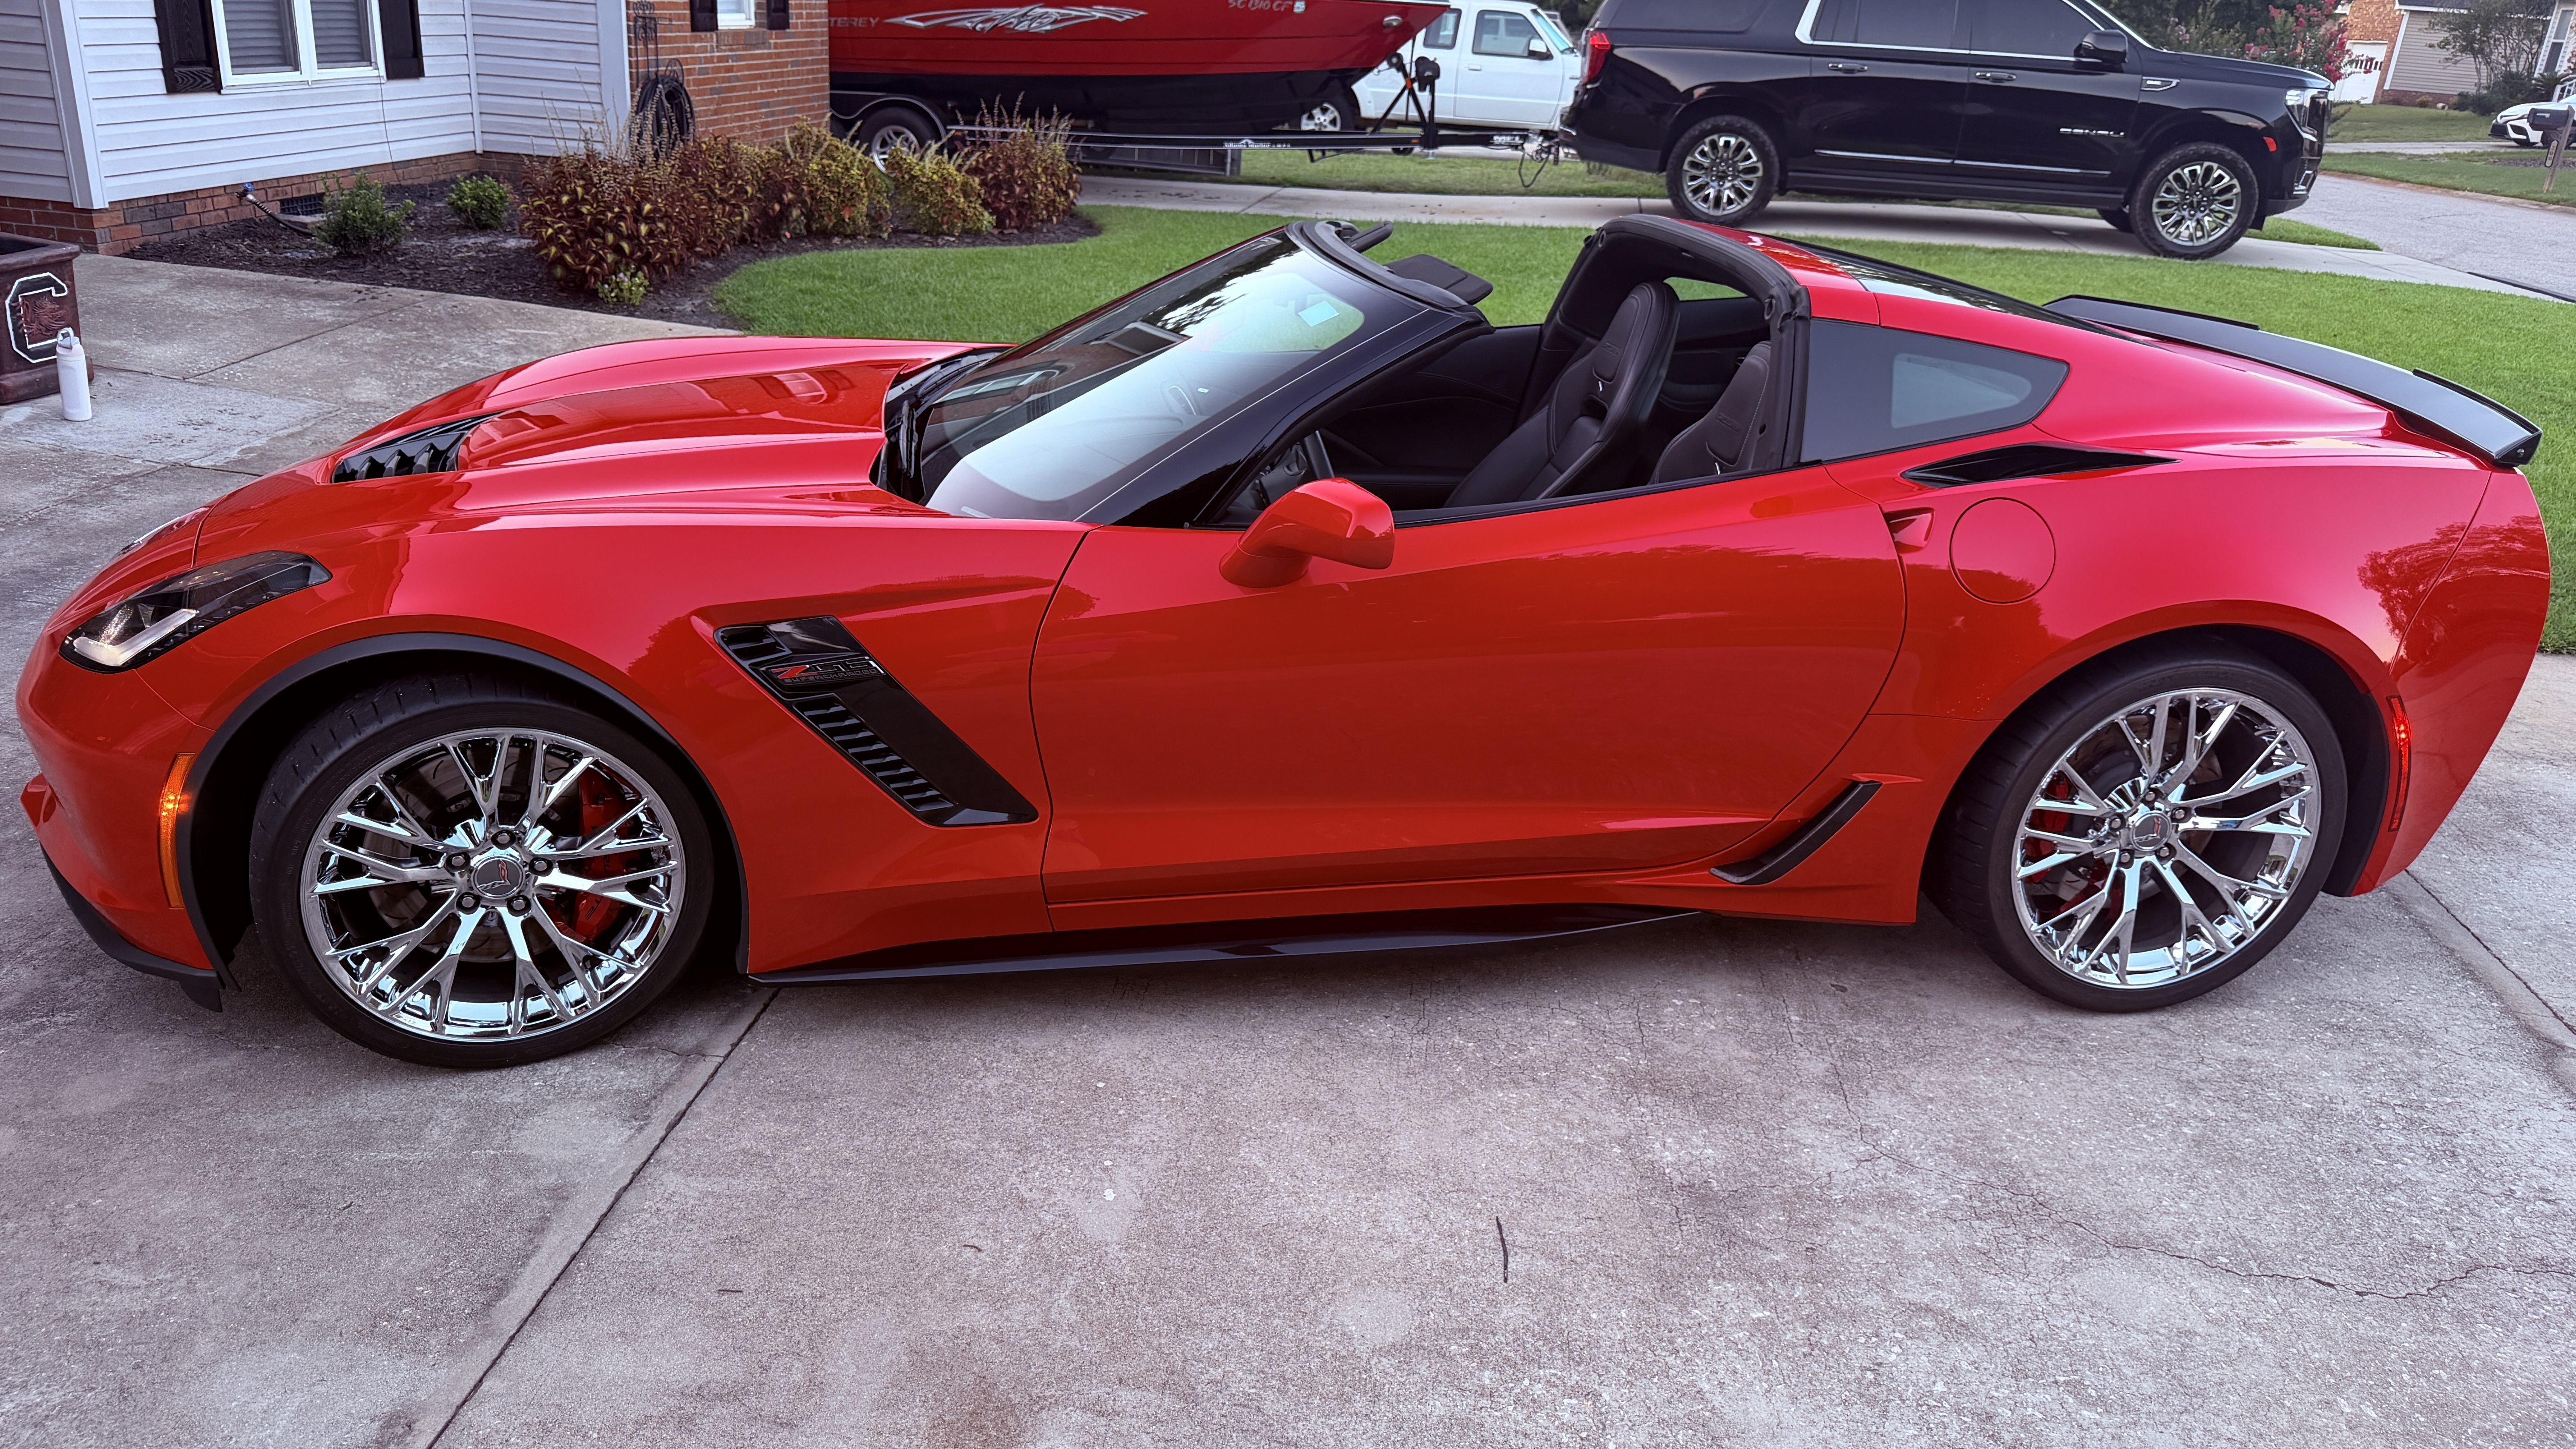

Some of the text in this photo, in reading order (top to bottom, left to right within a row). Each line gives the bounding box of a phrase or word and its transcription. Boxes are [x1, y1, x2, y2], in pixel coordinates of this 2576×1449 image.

[1272, 0, 1293, 11] CF
[828, 17, 880, 28] TEREY
[2059, 128, 2125, 138] DENALI
[769, 656, 885, 680] Z06
